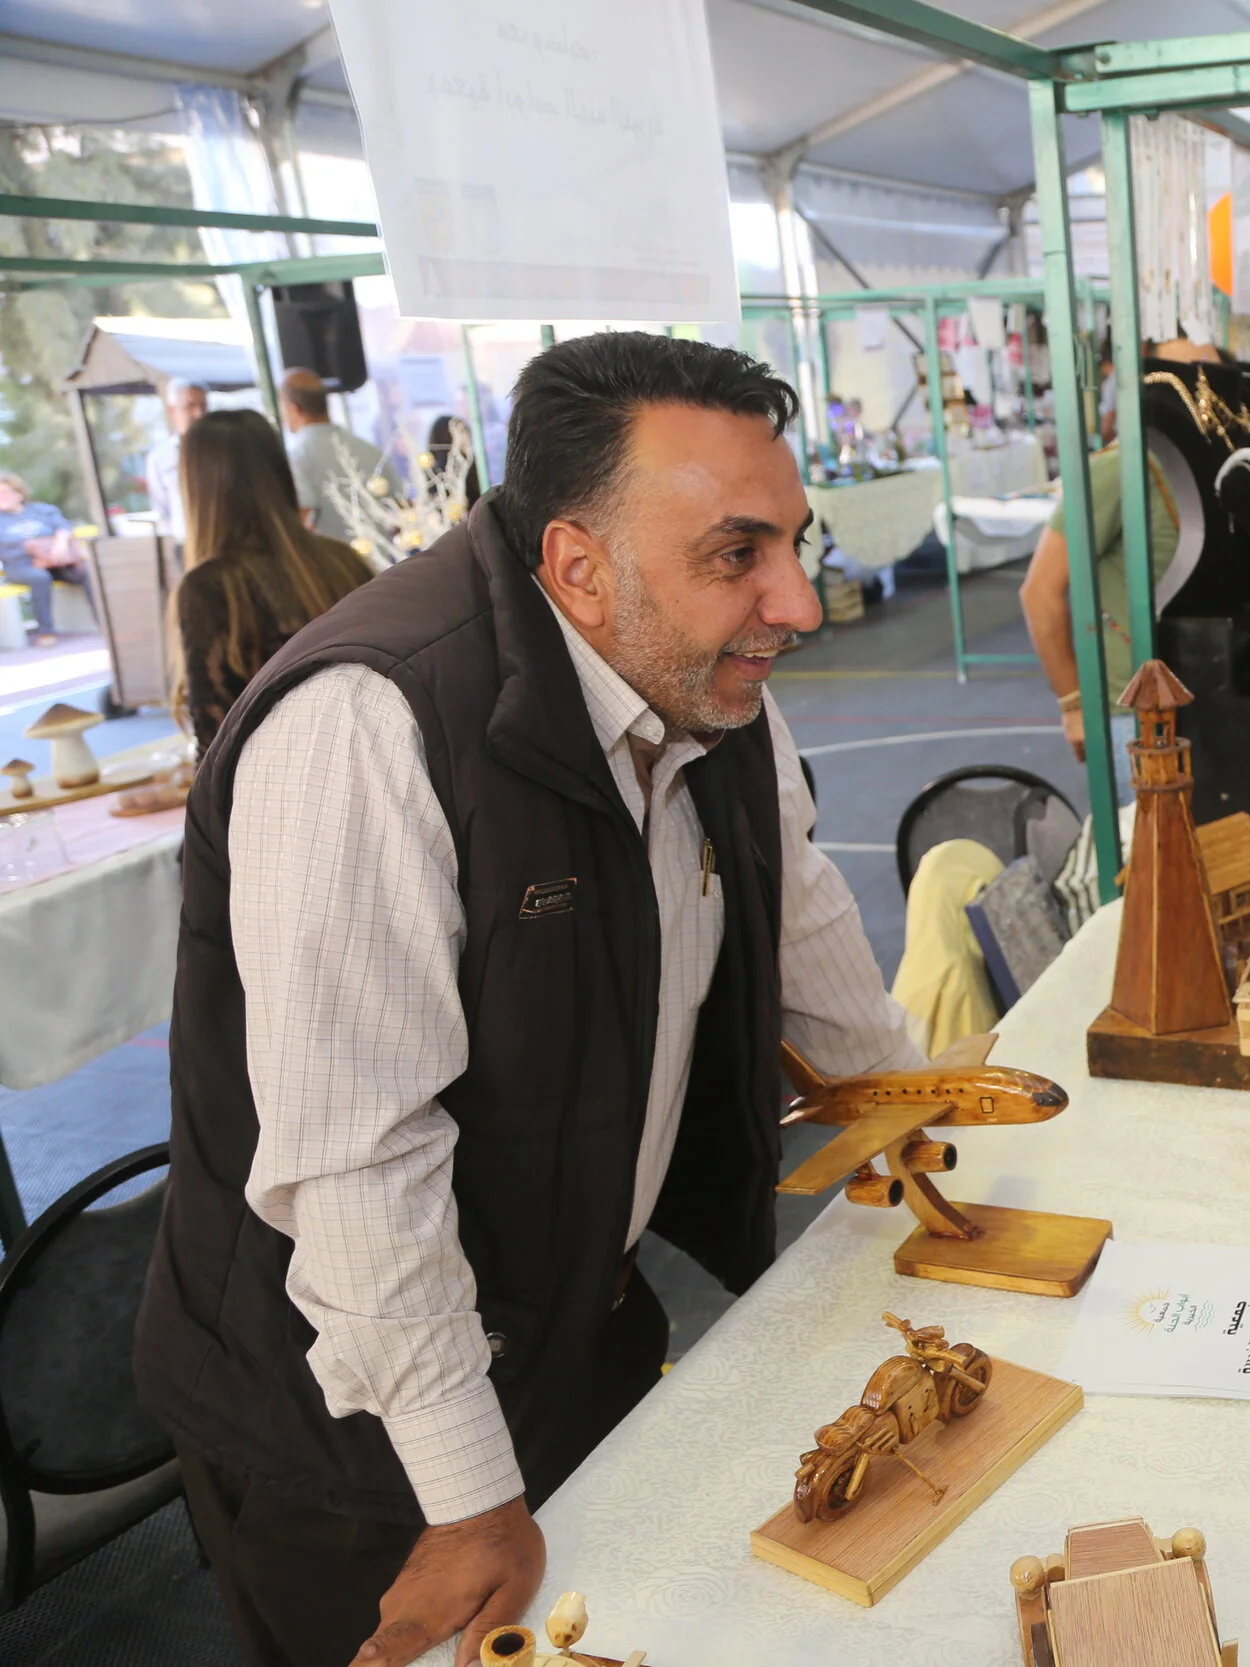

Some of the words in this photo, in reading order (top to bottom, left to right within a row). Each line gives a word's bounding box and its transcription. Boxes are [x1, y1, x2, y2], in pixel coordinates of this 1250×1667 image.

[1153, 1302, 1170, 1322] جمعية
[1182, 1304, 1197, 1326] الخيرية
[1222, 1301, 1250, 1335] جمعية
[1163, 1313, 1181, 1333] الجنة
